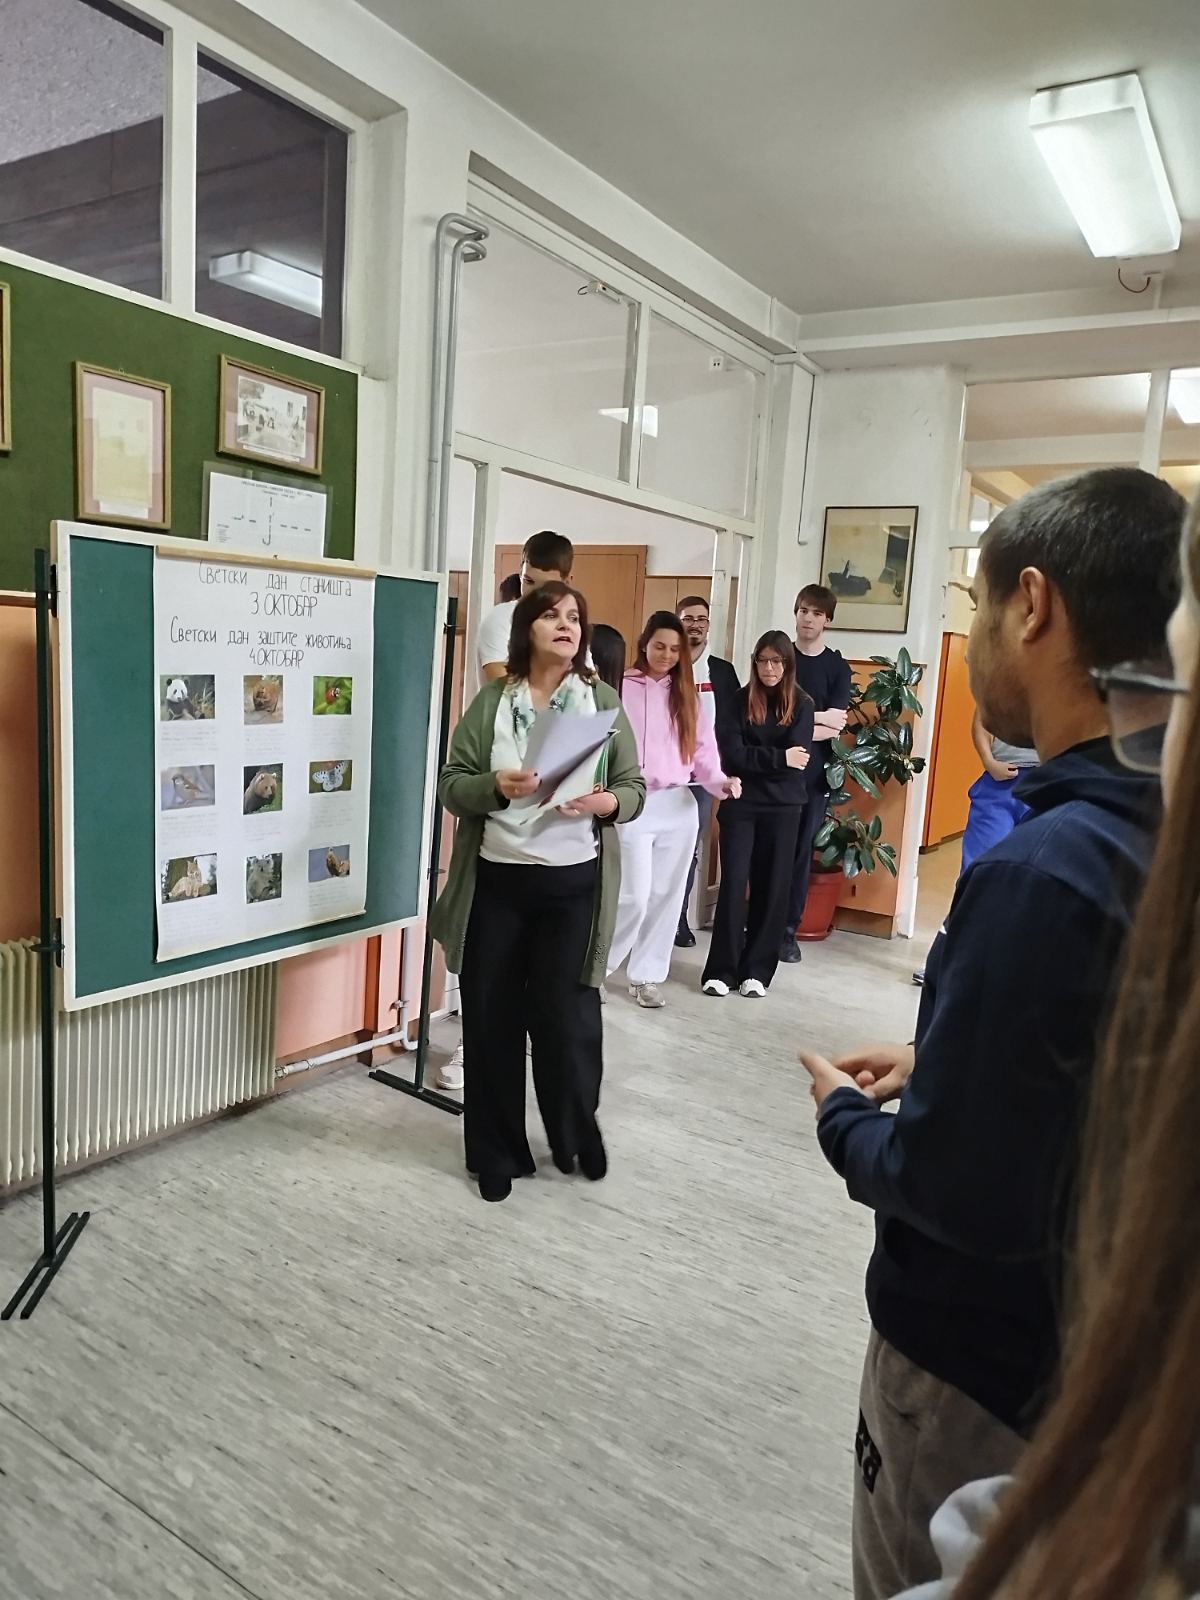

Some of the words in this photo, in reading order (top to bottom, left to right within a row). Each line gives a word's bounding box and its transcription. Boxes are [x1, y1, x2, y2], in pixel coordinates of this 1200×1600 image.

[199, 560, 248, 585] Светски
[265, 573, 288, 591] дан
[300, 575, 352, 597] станишта
[264, 592, 318, 618] ОКТОБАР
[170, 616, 217, 643] Светски
[227, 630, 249, 646] дан
[257, 630, 298, 647] заштите
[305, 633, 352, 650] животиња
